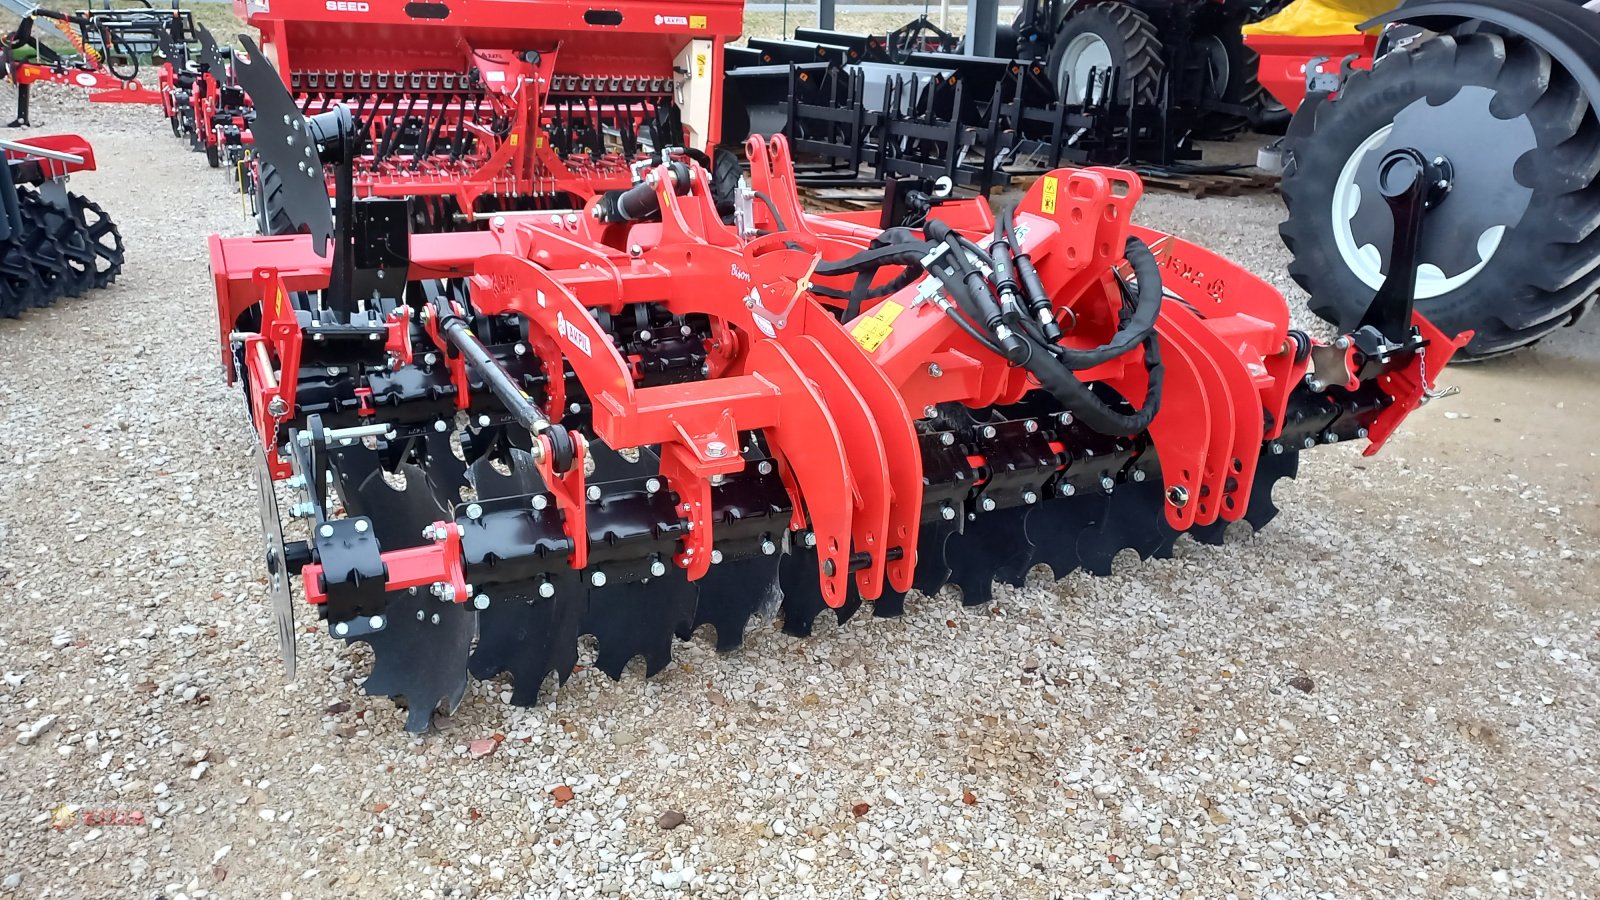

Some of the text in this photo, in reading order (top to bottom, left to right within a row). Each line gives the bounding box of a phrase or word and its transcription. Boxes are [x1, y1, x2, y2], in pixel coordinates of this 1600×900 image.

[325, 0, 370, 12] SEED
[731, 263, 751, 282] Bison
[568, 324, 590, 353] AKPIL
